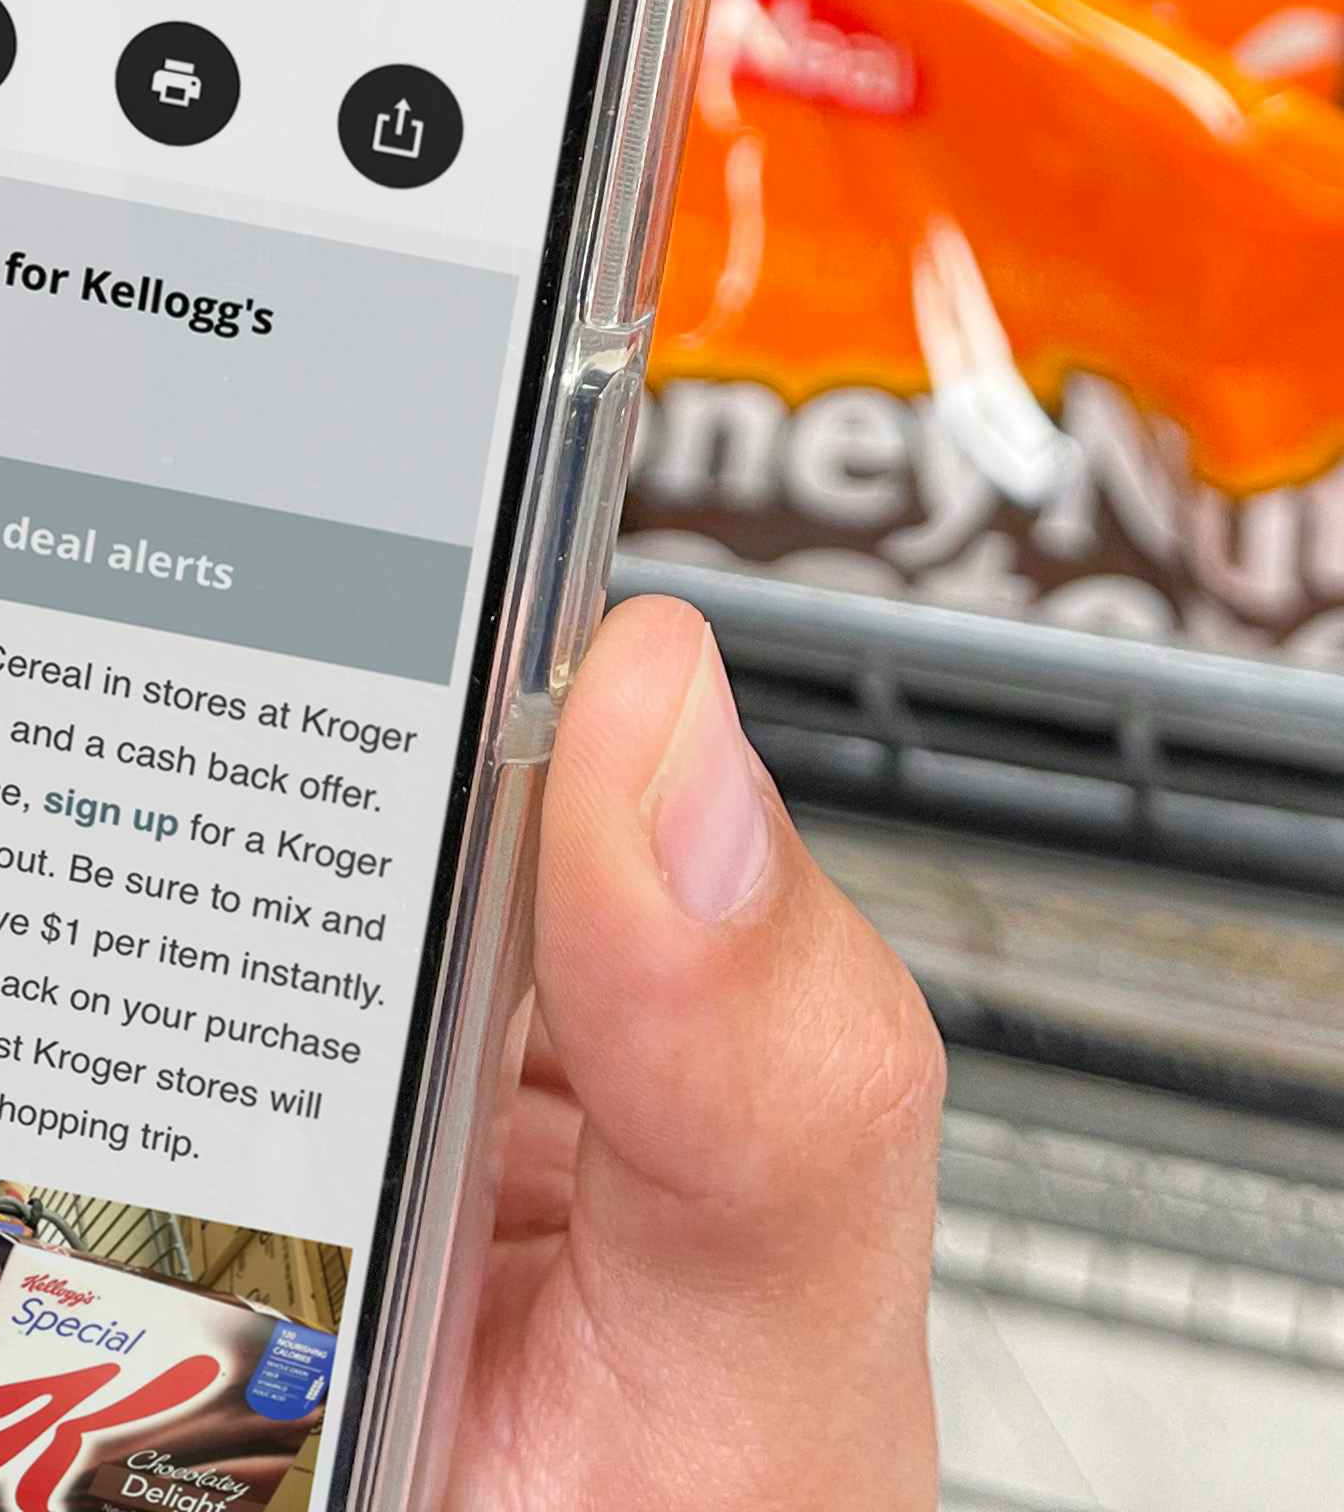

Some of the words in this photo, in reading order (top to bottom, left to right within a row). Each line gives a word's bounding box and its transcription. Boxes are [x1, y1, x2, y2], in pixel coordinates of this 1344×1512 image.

[4, 251, 69, 296] for
[80, 267, 276, 339] Kellogg's
[0, 516, 96, 563] deal
[106, 535, 235, 591] alerts
[142, 679, 247, 721] stores
[301, 704, 418, 754] Kroger
[10, 721, 75, 752] and
[116, 741, 196, 776] cash
[207, 751, 289, 795] back
[299, 773, 380, 813] offer.
[43, 788, 121, 828] sign
[190, 813, 236, 847] for
[277, 829, 393, 879] Kroger
[68, 853, 114, 889] Be
[124, 872, 200, 905] sure
[251, 895, 312, 928] mix
[321, 910, 387, 942] and
[40, 911, 79, 946] $1
[92, 929, 151, 959] per
[159, 935, 230, 976] item
[241, 951, 384, 1011] instantly.
[120, 998, 198, 1031] your
[204, 1015, 361, 1064] purchase
[33, 1037, 147, 1086] Kroger
[155, 1067, 258, 1108] stores
[270, 1090, 323, 1120] will
[141, 1123, 199, 1162] trip.
[11, 1297, 146, 1356] Special
[21, 1274, 97, 1307] Kellogg's
[126, 1449, 250, 1502] Chocolatey
